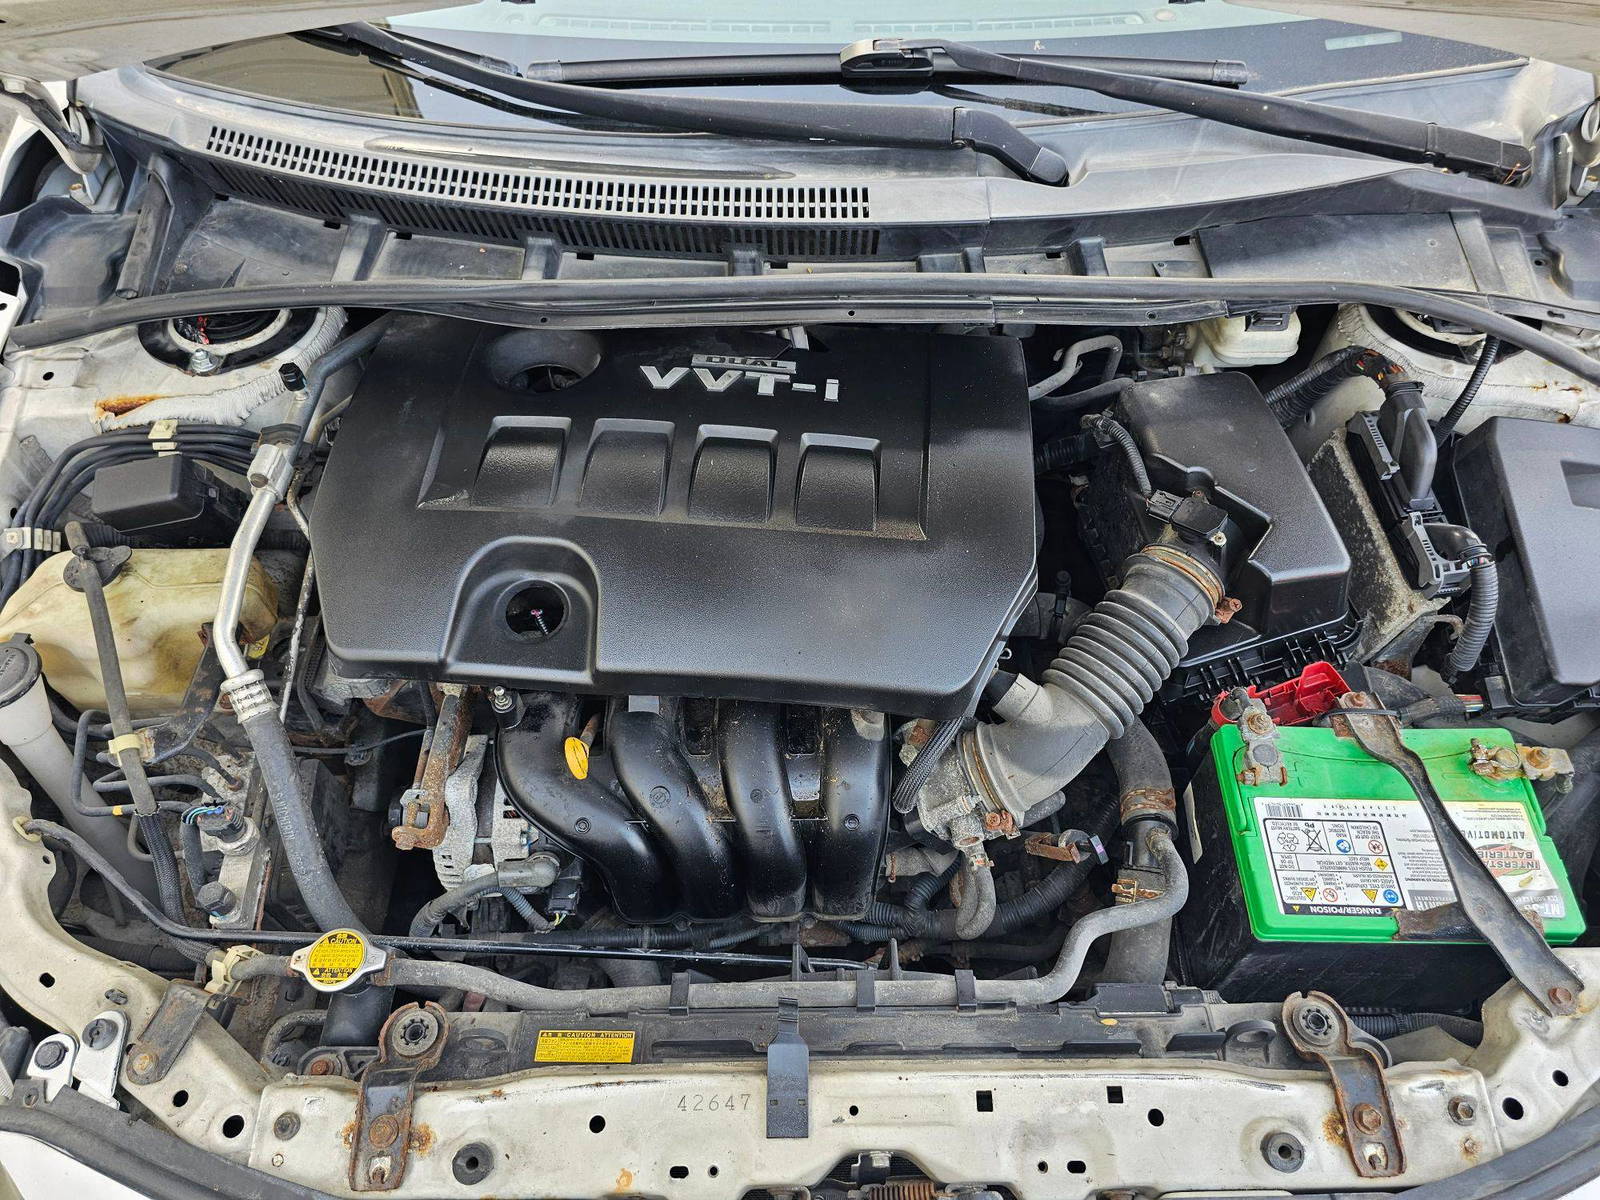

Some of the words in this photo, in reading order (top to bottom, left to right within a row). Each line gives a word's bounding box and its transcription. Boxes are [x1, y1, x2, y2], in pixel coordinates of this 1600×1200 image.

[706, 355, 787, 369] DUAL
[1476, 851, 1533, 859] BATTERIE
[1481, 860, 1538, 869] INTERSTA
[1309, 905, 1382, 915] DANGER/POISON
[677, 1093, 751, 1111] 42647
